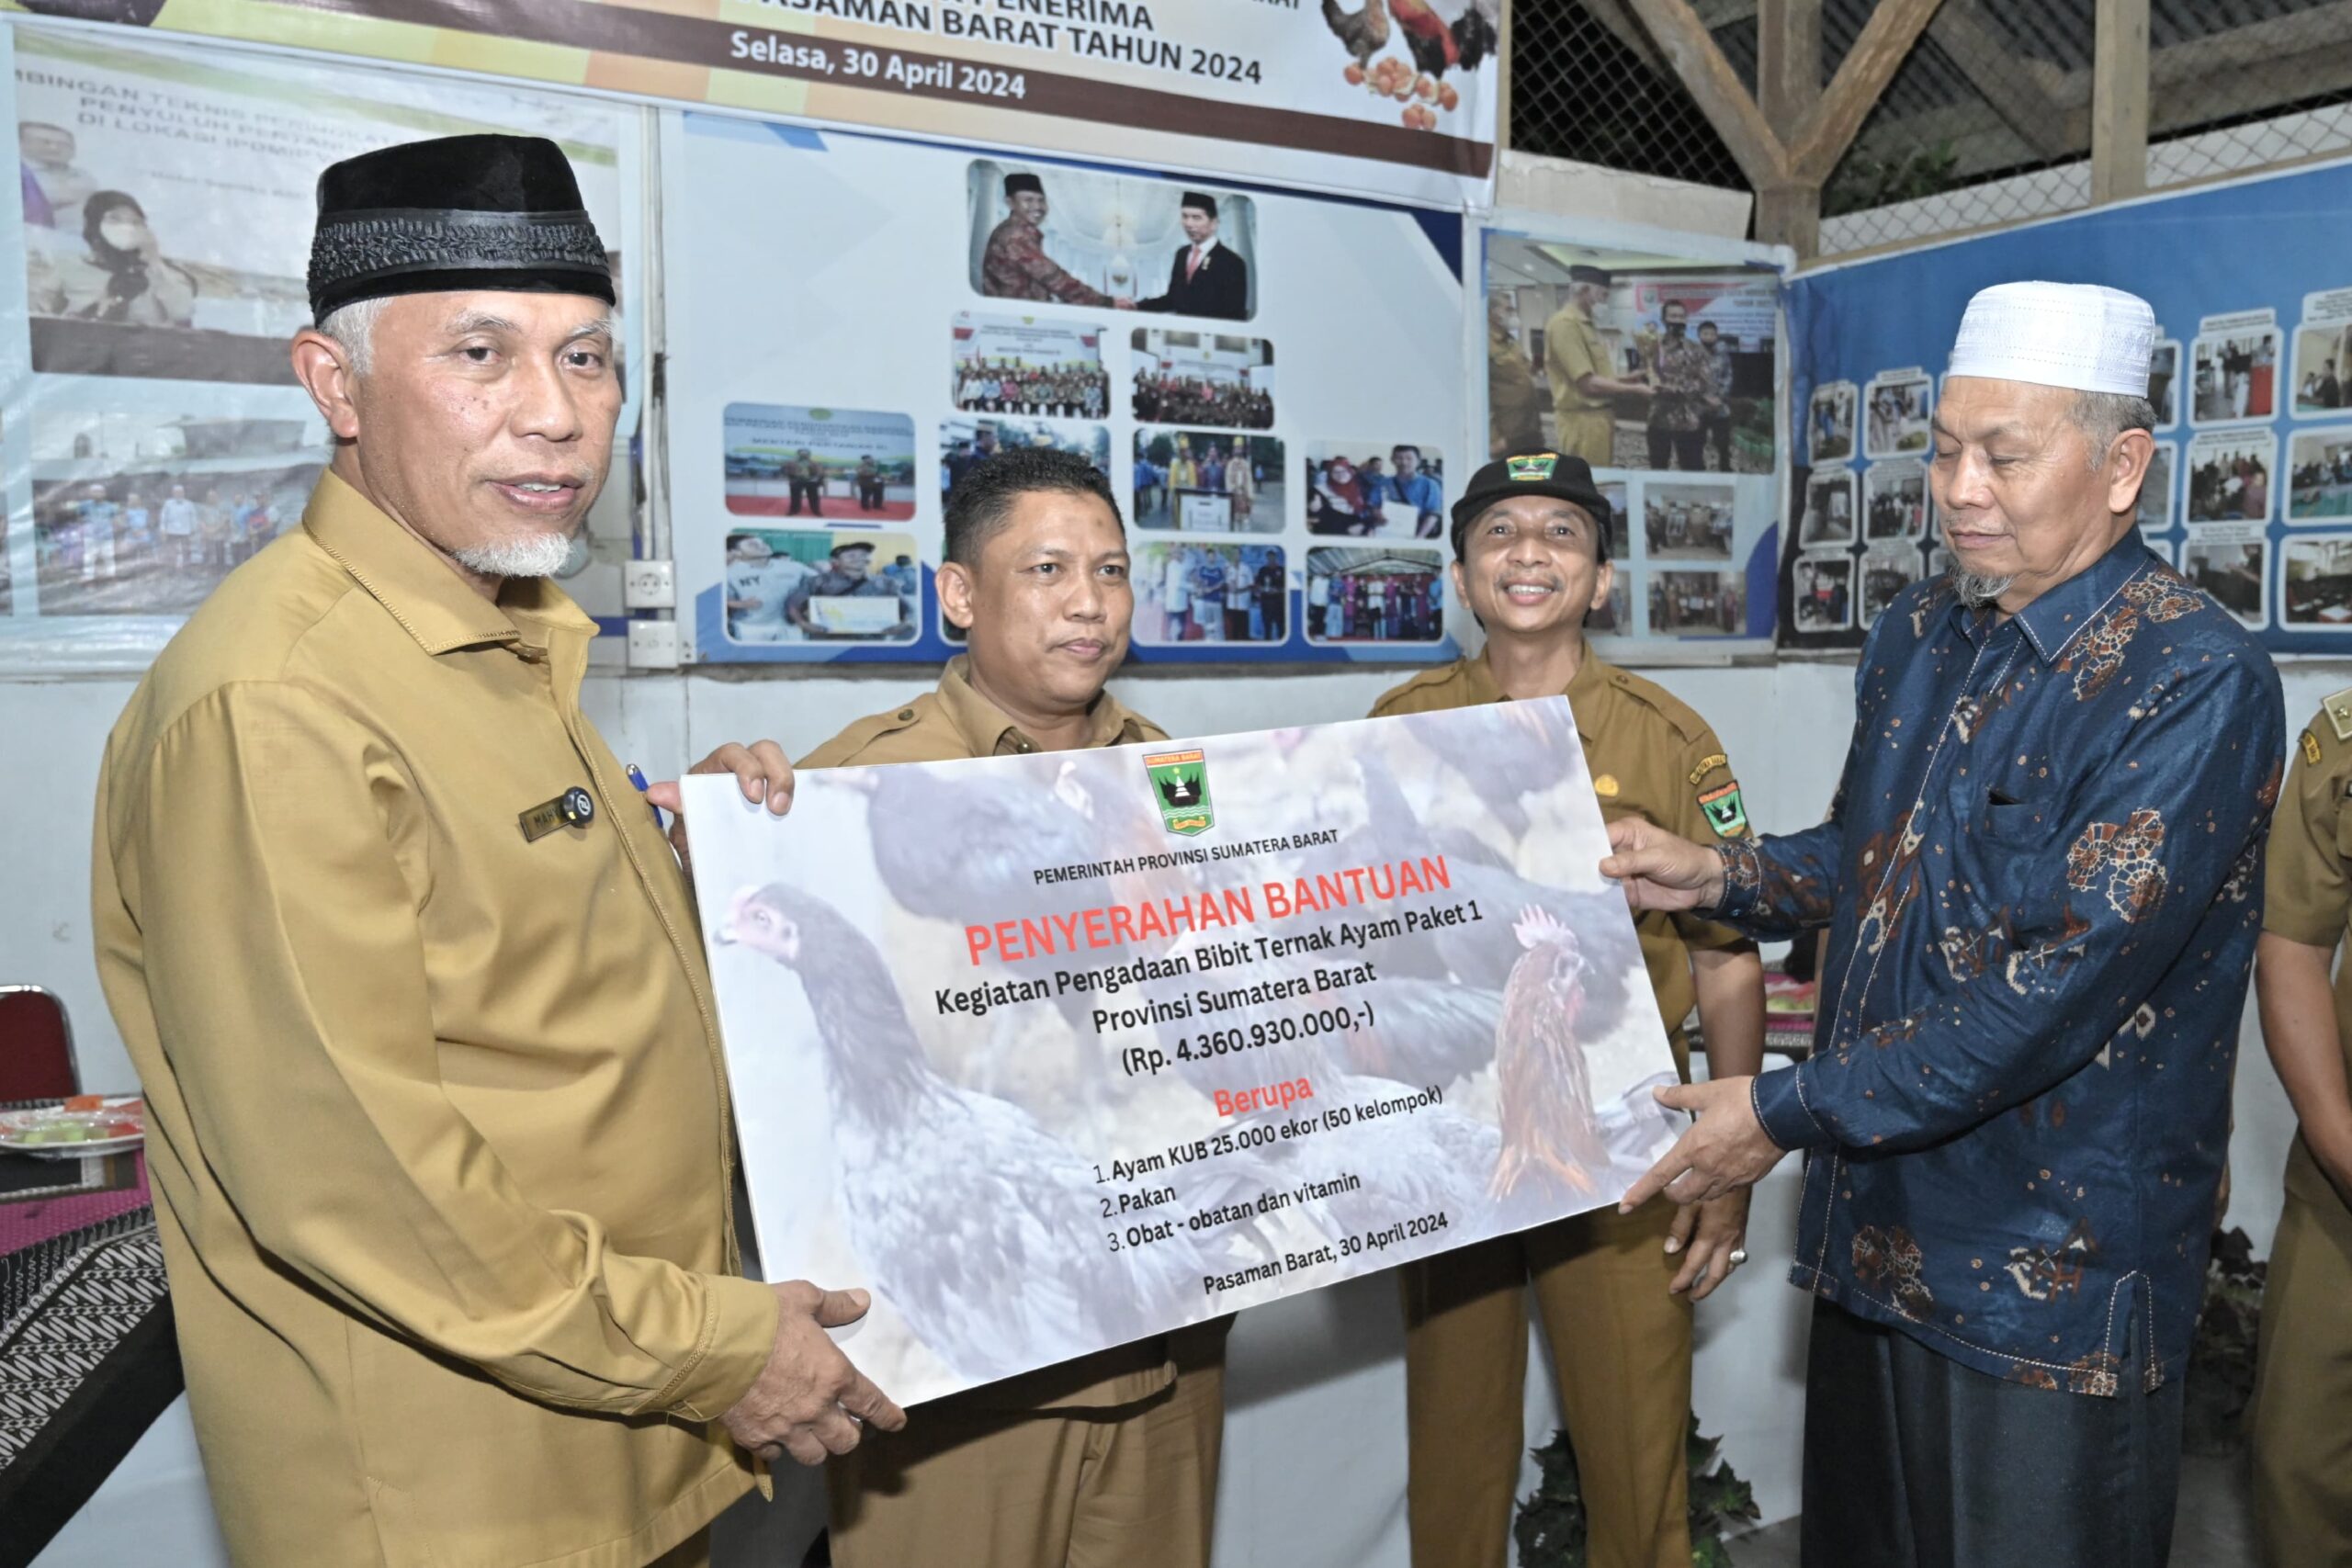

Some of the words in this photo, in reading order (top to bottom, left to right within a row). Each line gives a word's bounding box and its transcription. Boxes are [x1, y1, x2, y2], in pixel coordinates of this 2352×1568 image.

[730, 31, 835, 75] Selasa,
[842, 49, 879, 77] 30
[885, 55, 953, 89] April
[958, 66, 1026, 99] 2024
[943, 9, 1058, 49] BARAT
[1067, 27, 1182, 71] TAHUN
[1191, 49, 1262, 85] 2024
[1034, 858, 1135, 885] PEMERINTAH
[1137, 849, 1208, 871] PROVINSI
[1211, 837, 1291, 861] SUMATERA
[1293, 829, 1338, 849] BARAT
[965, 886, 1256, 966] PENYERAHAN
[1263, 854, 1451, 919] BANTUAN
[935, 978, 1050, 1016] Kegiatan
[1055, 955, 1190, 995] Pengadaan
[1194, 942, 1253, 971] Bibit
[1254, 926, 1336, 960] Ternak
[1340, 918, 1402, 949] Ayam
[1404, 903, 1466, 933] Paket
[1469, 899, 1483, 920] 1
[1092, 993, 1193, 1034] Provinsi
[1196, 977, 1311, 1014] Sumatera
[1313, 961, 1377, 991] Barat
[1122, 1047, 1171, 1077] (Rp.
[1176, 1000, 1374, 1063] 4.360.930.000,-)
[1093, 1165, 1110, 1184] 1.
[1111, 1155, 1165, 1182] Ayam
[1169, 1140, 1208, 1167] KUB
[1211, 1125, 1276, 1156] 25.000
[1280, 1116, 1318, 1141] ekor
[1323, 1106, 1351, 1134] (50
[1355, 1085, 1443, 1122] kelompok)
[1214, 1077, 1314, 1117] Berupa
[1100, 1198, 1118, 1219] 2.
[1119, 1186, 1176, 1214] Pakan
[1107, 1233, 1125, 1253] 3.
[1125, 1219, 1174, 1247] Obat
[1189, 1201, 1253, 1232] obatan
[1257, 1190, 1290, 1215] dan
[1293, 1173, 1362, 1206] vitamin
[1203, 1261, 1283, 1295] Pasaman
[1285, 1245, 1338, 1273] Barat,
[1339, 1235, 1363, 1258] 30
[1365, 1223, 1407, 1255] April
[1407, 1211, 1449, 1237] 2024
